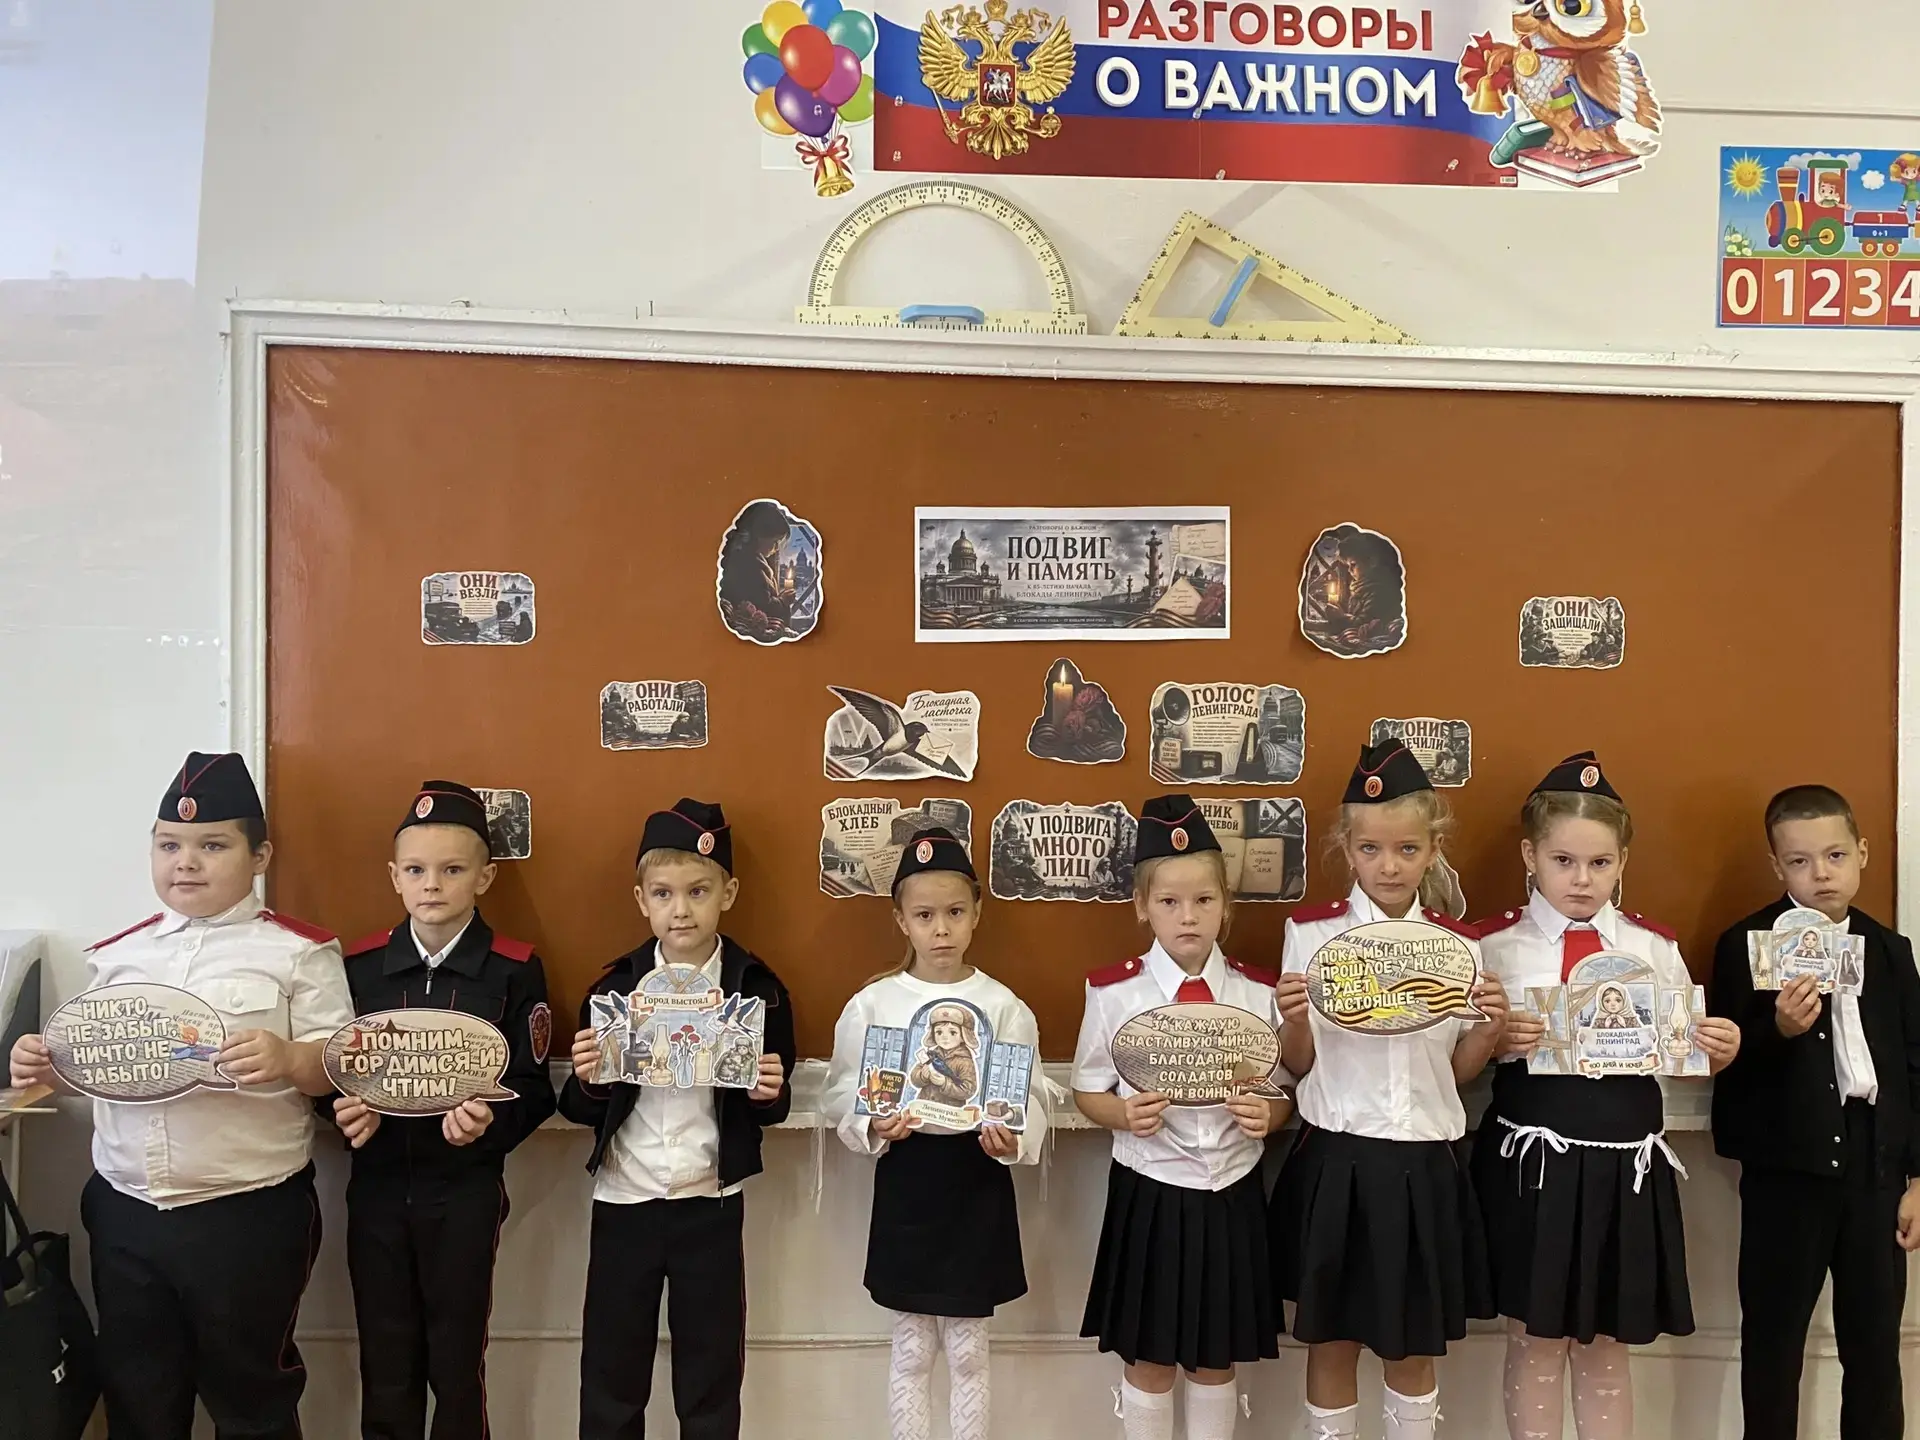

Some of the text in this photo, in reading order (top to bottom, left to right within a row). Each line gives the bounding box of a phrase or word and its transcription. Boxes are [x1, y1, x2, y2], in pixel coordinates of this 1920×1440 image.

[1098, 0, 1433, 51] РАЗГОВОРЫ
[1096, 57, 1437, 118] О ВАЖНОМ
[1878, 213, 1883, 223] 1
[1726, 268, 1920, 318] 0 1 2 3 4
[1008, 536, 1112, 561] ПОДВИГ
[1008, 562, 1116, 580] И ПАМЯТЬ
[460, 574, 498, 589] ОНИ
[459, 588, 500, 600] ВЕЗЛИ
[1554, 601, 1589, 617] ОНИ
[1542, 616, 1600, 632] ЗАЩИЩАЛИ
[636, 682, 672, 699] ОНИ
[1191, 686, 1255, 706] ГОЛОС
[628, 699, 684, 713] РАБОТАЛИ
[912, 694, 971, 711] Блокадная
[1191, 703, 1259, 718] ЛЕНИНГРАДА
[920, 706, 973, 718] ласточка
[1405, 721, 1440, 737] ОНИ
[828, 802, 893, 820] БЛОКАДНЫЙ
[1200, 804, 1232, 819] НИК
[838, 816, 879, 832] ХЛЕБ
[1024, 815, 1111, 838] У ПОДВИГА
[1032, 836, 1106, 858] МНОГО
[1042, 858, 1090, 878] ЛИЦ
[1318, 947, 1358, 964] ПОКА
[1362, 946, 1388, 960] МЫ
[1393, 936, 1456, 958] ПОМНИМ
[1320, 960, 1392, 980] ПРОШЛОЕ
[1398, 958, 1408, 974] У
[1414, 955, 1444, 971] НАС
[1321, 979, 1372, 997] БУДЕТ
[82, 996, 148, 1021] НИКТО
[644, 996, 708, 1006] Город выстоял
[1323, 991, 1420, 1013] НАСТОЯЩЕЕ.
[66, 1024, 94, 1045] НЕ
[101, 1017, 178, 1040] ЗАБЫТ,
[1152, 1018, 1170, 1031] ЗА
[1174, 1016, 1241, 1031] КАЖДУЮ
[361, 1028, 470, 1052] ПОМНИМ,
[1118, 1033, 1274, 1048] СЧАСТЛИВУЮ МИНУТУ
[1596, 1030, 1638, 1038] БЛОКАДНЫЙ
[72, 1040, 171, 1065] НИЧТО НЕ
[478, 1048, 498, 1069] И
[1149, 1052, 1244, 1067] БЛАГОДАРИМ
[82, 1062, 170, 1085] ЗАБЫТО!
[882, 1074, 902, 1082] НИКТО
[1159, 1069, 1234, 1084] СОЛДАТОВ
[381, 1076, 456, 1098] ЧТИМ!
[1188, 1084, 1240, 1099] ВОЙНЫ!
